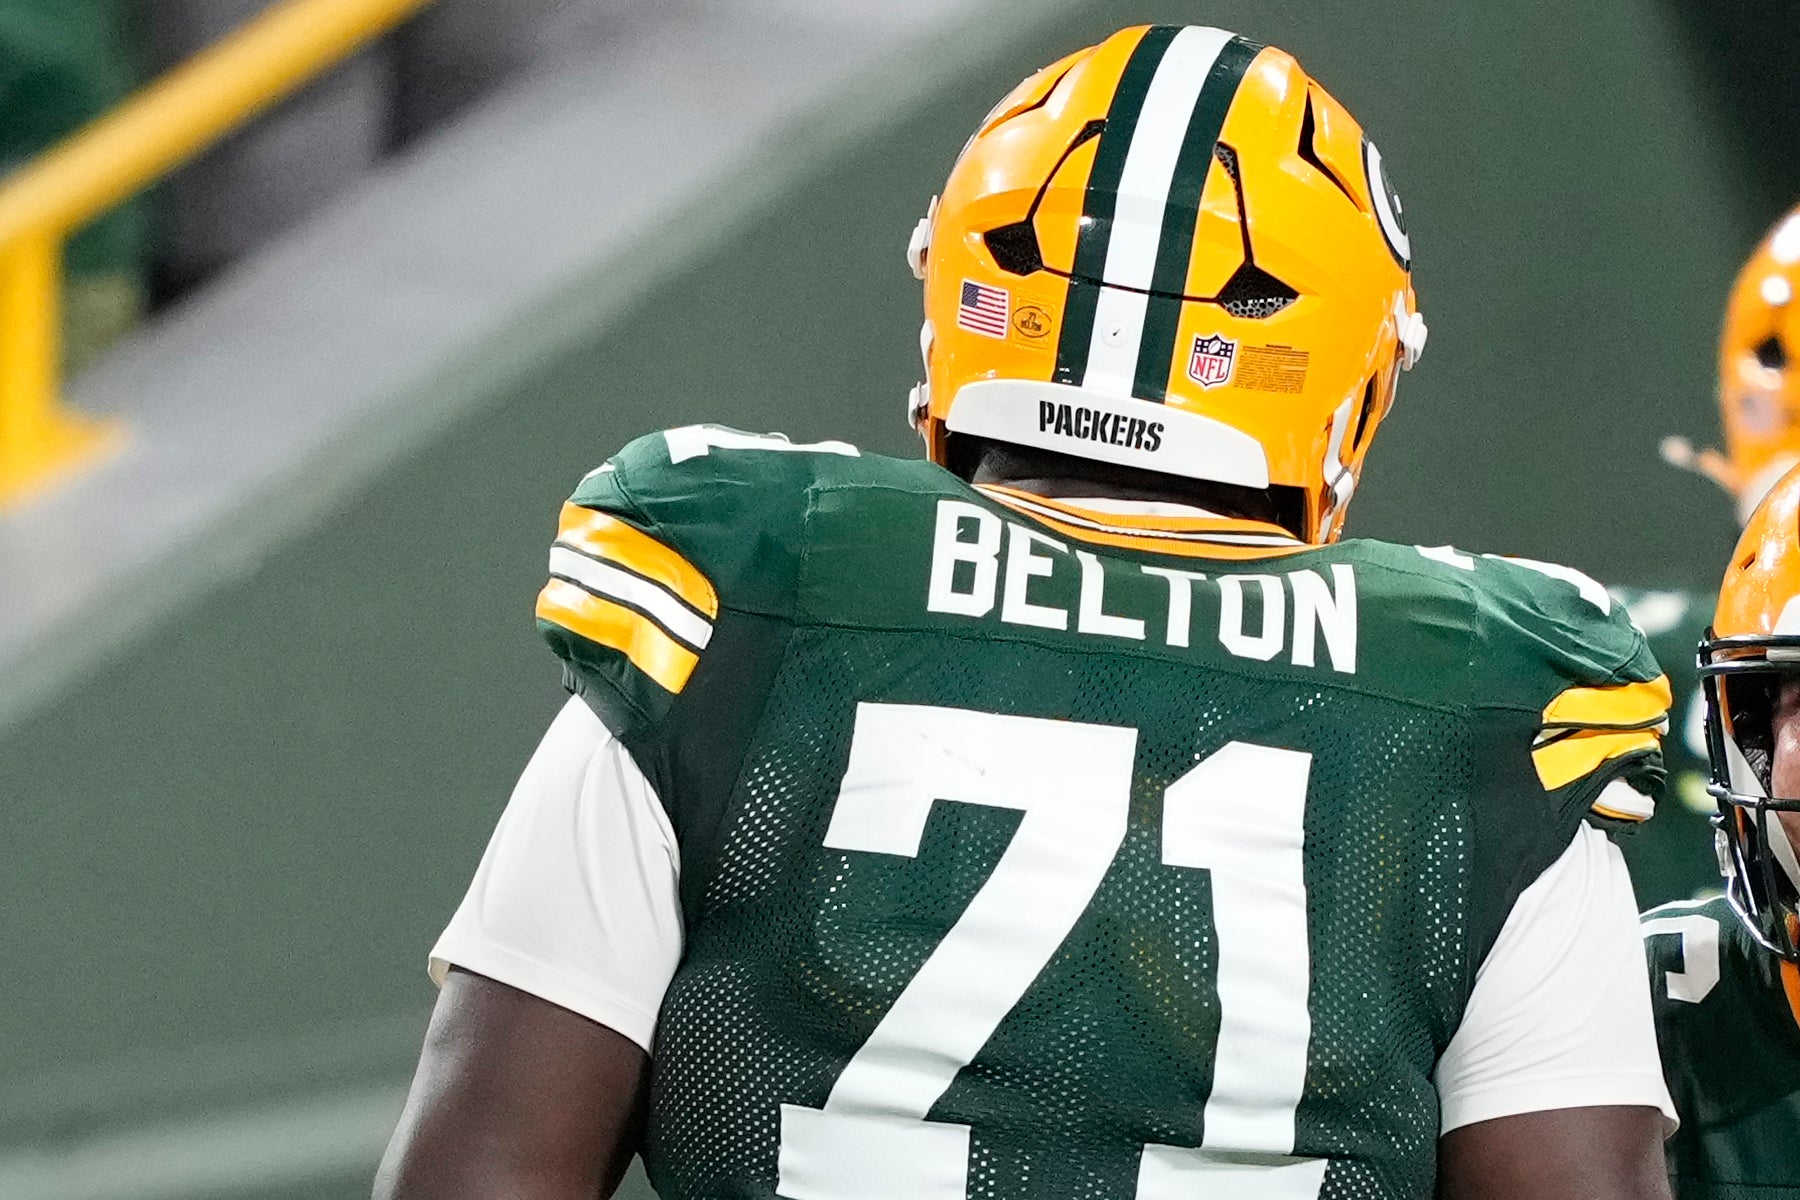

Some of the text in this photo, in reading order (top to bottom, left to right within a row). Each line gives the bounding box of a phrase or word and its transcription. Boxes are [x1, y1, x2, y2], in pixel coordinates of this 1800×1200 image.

[1193, 355, 1226, 381] NFL
[1039, 400, 1165, 452] PACKERS
[927, 499, 1358, 674] BELTON
